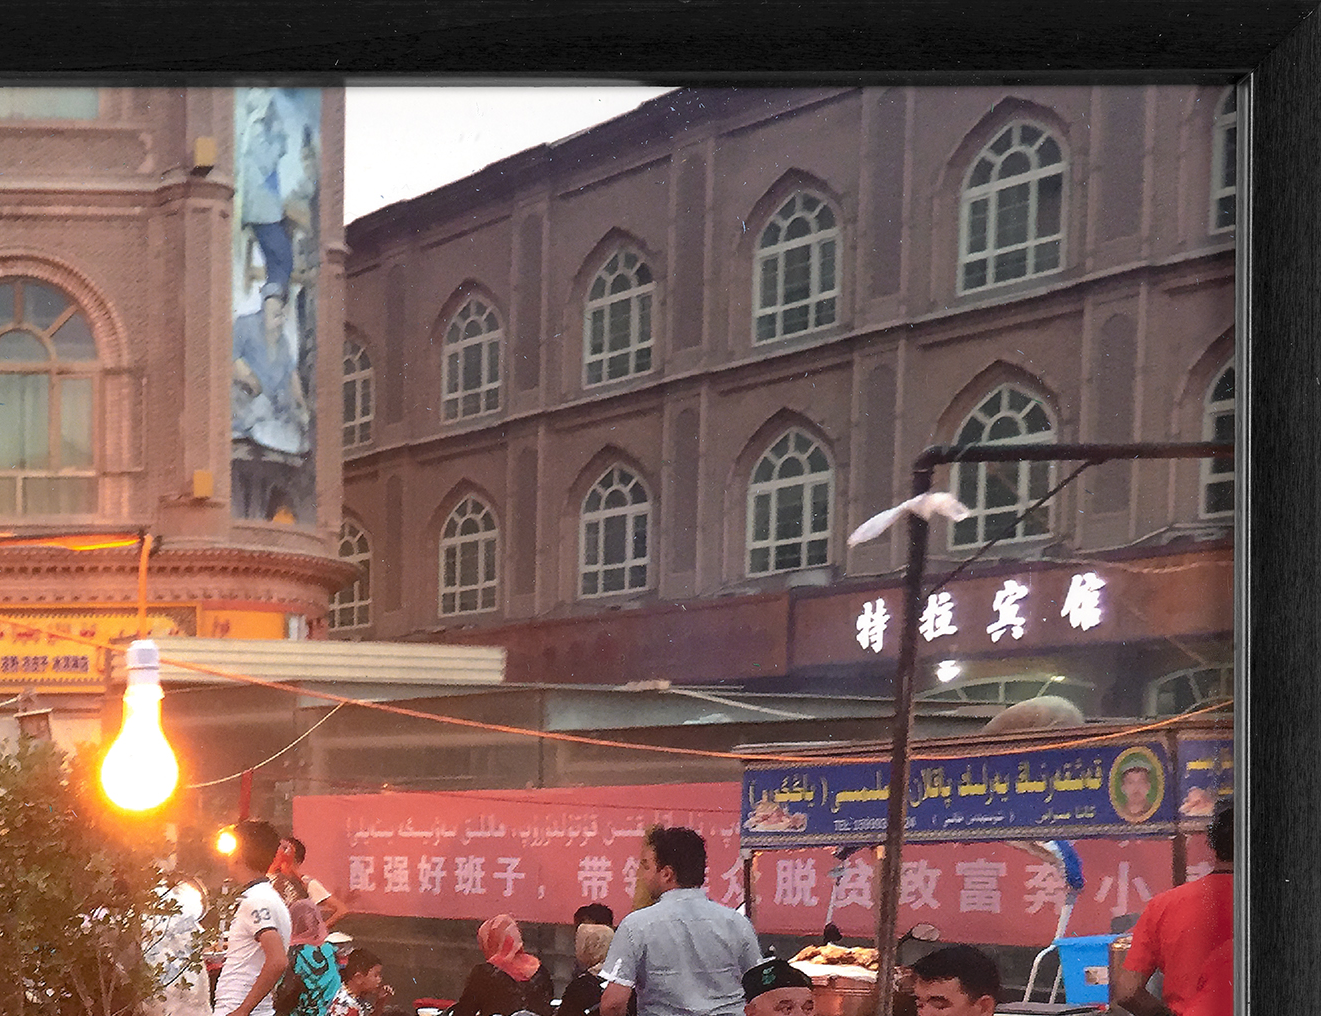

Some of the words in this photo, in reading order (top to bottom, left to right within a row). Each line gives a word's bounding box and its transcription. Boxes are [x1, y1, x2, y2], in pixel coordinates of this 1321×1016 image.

[856, 572, 1106, 653] 特拉宾馆
[250, 907, 272, 924] 33
